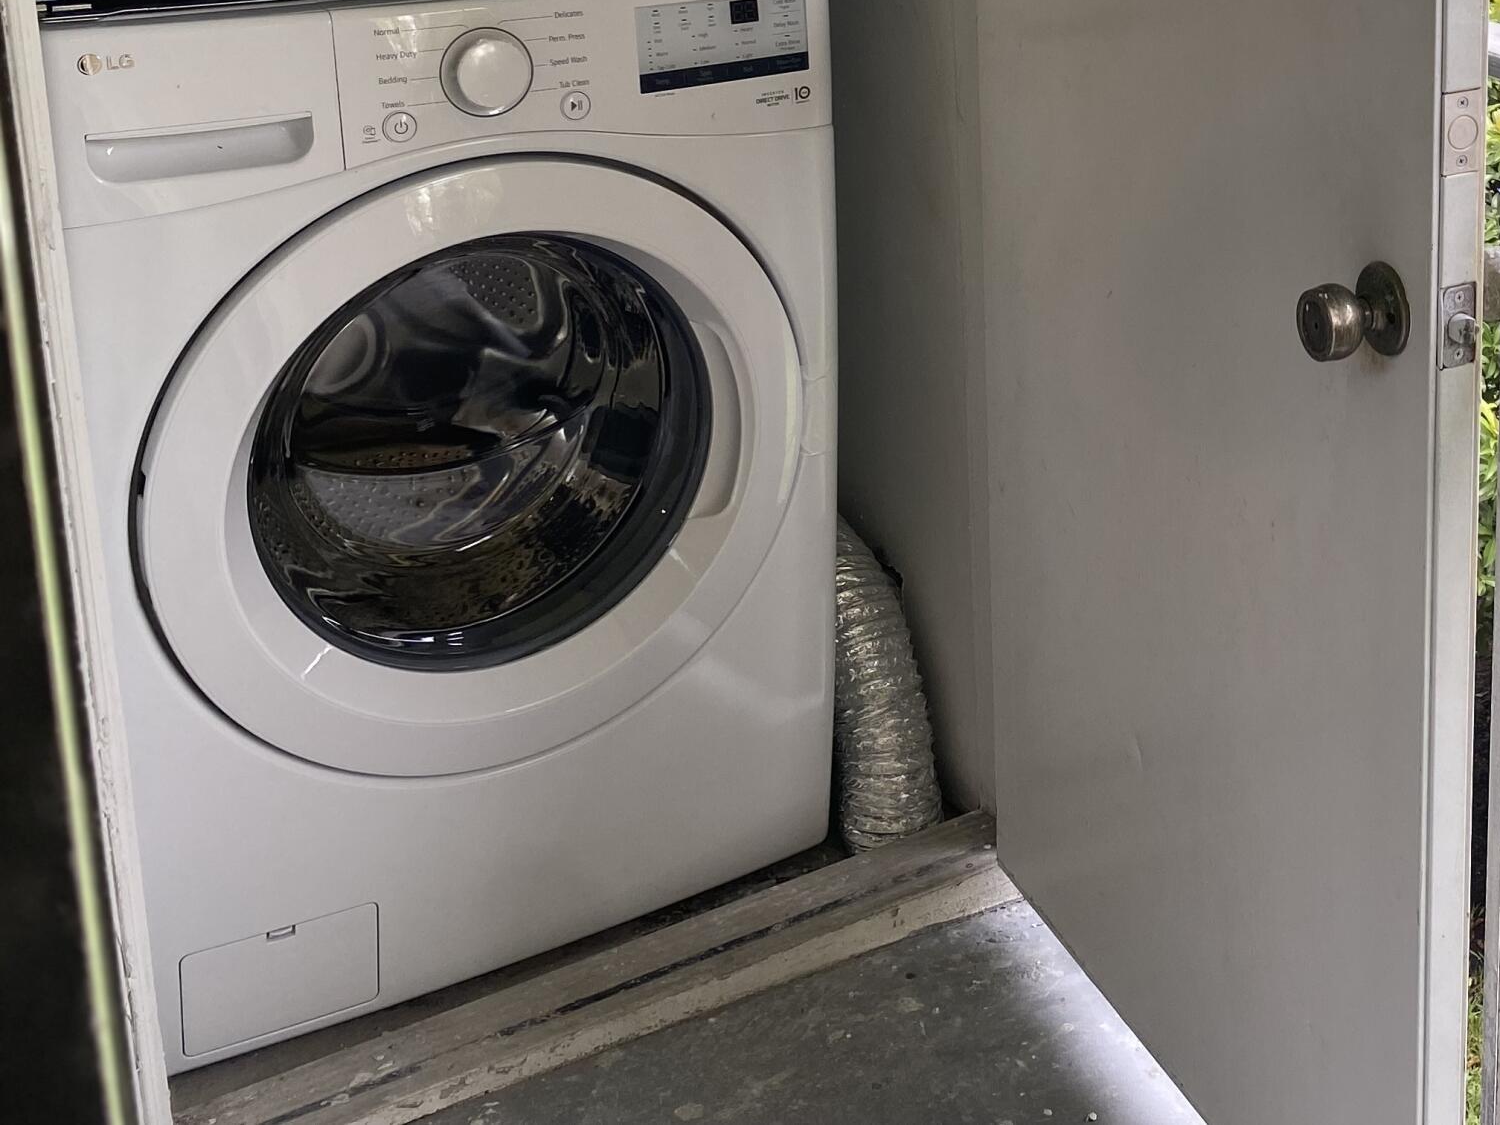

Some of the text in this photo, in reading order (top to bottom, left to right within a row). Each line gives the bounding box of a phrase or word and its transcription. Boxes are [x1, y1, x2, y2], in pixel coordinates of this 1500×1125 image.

[554, 11, 584, 19] Delicates
[373, 28, 400, 36] Normal
[376, 50, 417, 61] Heavy Duty
[105, 54, 135, 70] LG
[550, 58, 569, 67] Speed
[378, 76, 408, 85] Bedding
[756, 96, 774, 104] DIRECT
[775, 94, 790, 102] DRIVE
[381, 101, 405, 109] Towels
